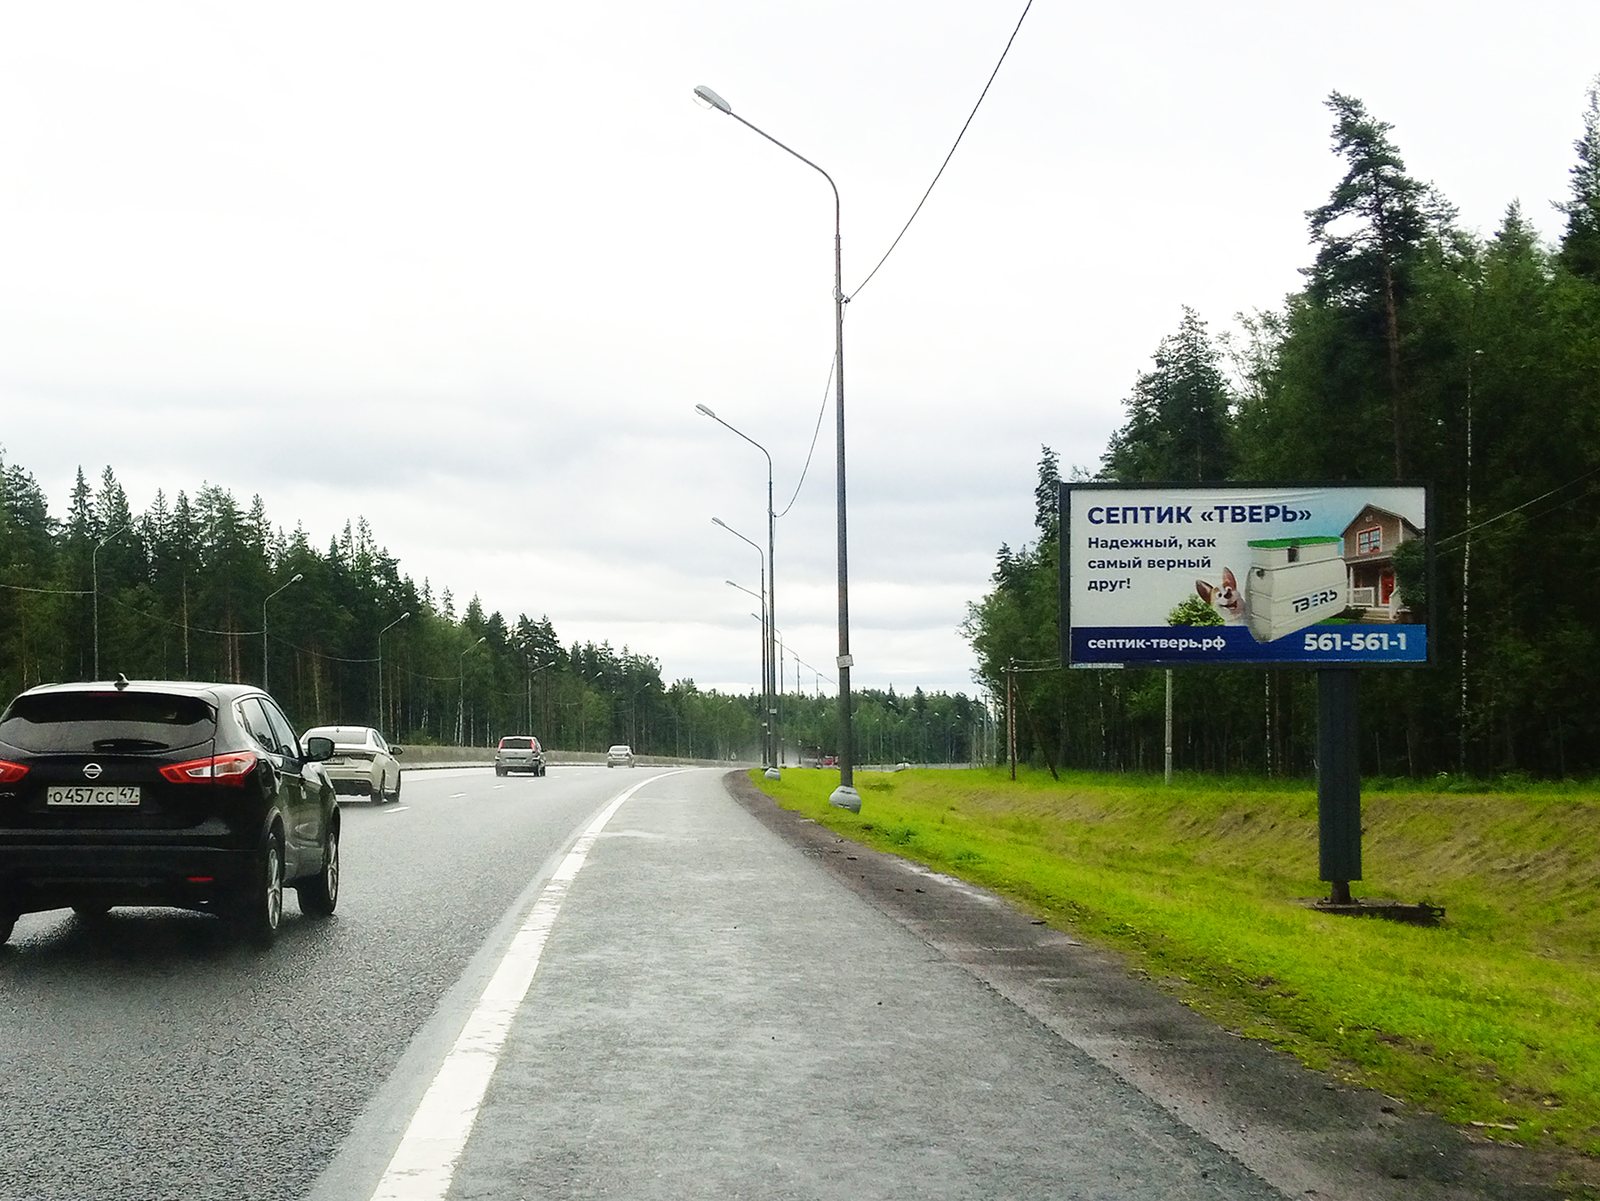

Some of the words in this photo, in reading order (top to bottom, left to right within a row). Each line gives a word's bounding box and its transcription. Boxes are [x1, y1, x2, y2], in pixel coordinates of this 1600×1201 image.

[1087, 506, 1192, 524] СЕПТИК
[1201, 505, 1312, 523] «ТВЕРЬ»
[1088, 536, 1183, 550] Надежный,
[1188, 538, 1216, 548] как
[1088, 557, 1142, 569] самый
[1147, 556, 1211, 571] верный
[1088, 578, 1131, 592] друг!
[1087, 635, 1226, 651] септик-тверь.рф
[1303, 633, 1406, 651] 561-561-1
